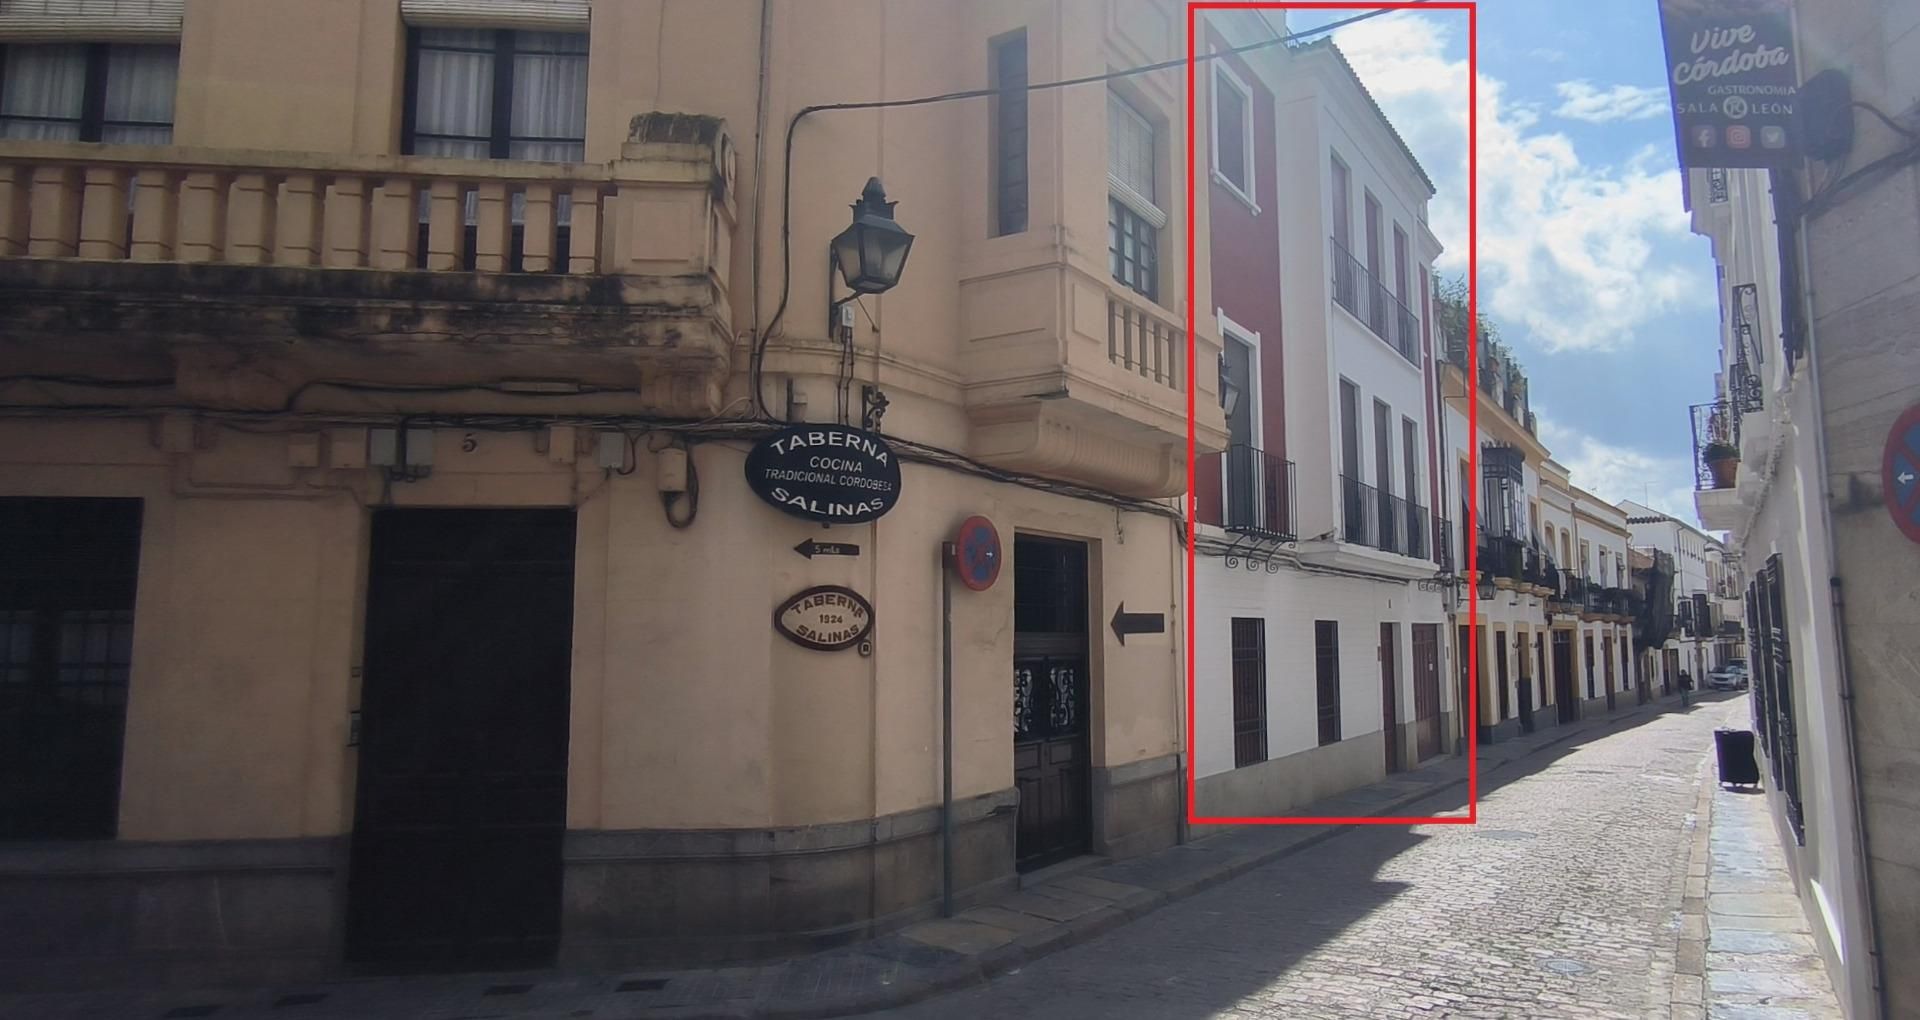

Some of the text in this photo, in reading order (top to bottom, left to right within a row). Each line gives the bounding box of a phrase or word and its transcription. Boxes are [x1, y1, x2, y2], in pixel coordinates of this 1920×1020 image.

[1690, 24, 1756, 54] Vive
[1673, 44, 1790, 86] Córdoba
[1676, 103, 1719, 114] SALA
[462, 433, 478, 453] 5
[770, 431, 888, 468] TABERNA
[809, 456, 863, 473] COCINA
[765, 468, 892, 491] TRADICIONAL CORDOBESA
[771, 487, 884, 516] SALINAS
[791, 594, 865, 618] TABERNA
[819, 614, 843, 624] 1924
[796, 624, 859, 642] SALINAS
